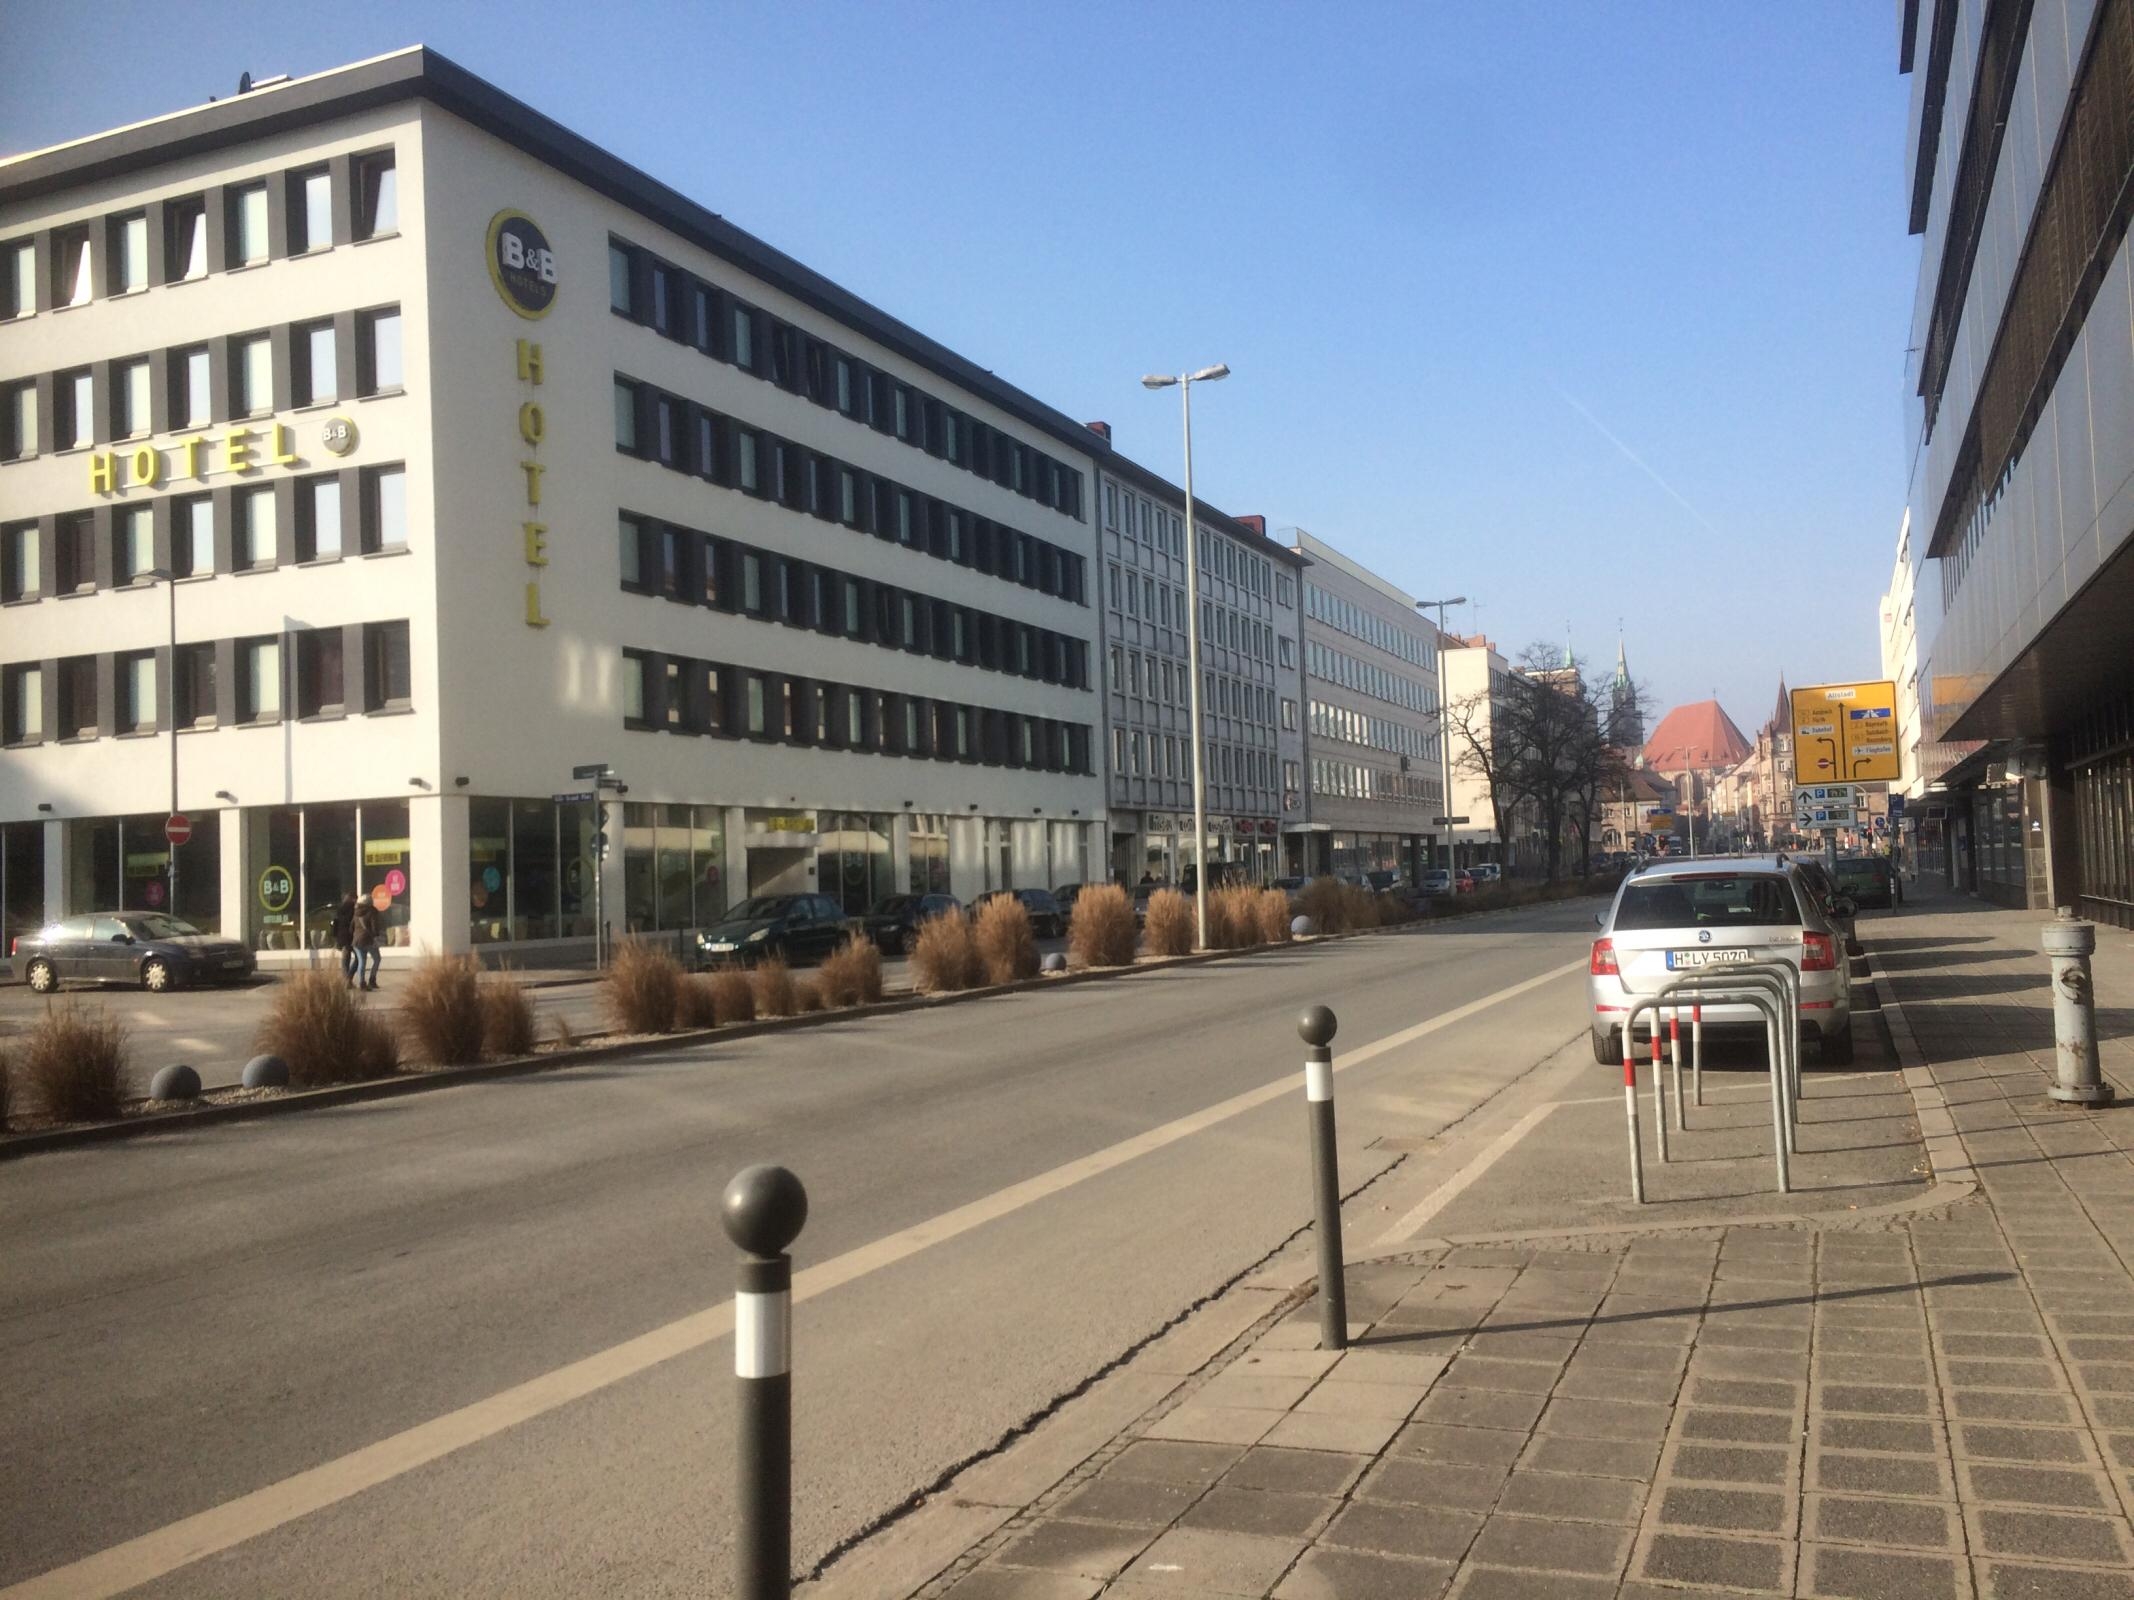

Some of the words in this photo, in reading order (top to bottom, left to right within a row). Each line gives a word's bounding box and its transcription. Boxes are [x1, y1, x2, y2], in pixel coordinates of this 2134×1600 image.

[501, 231, 559, 285] B&B
[322, 425, 347, 441] B&B
[89, 423, 298, 494] HOTEL
[516, 338, 551, 628] HOTEL
[1816, 789, 1824, 798] P
[263, 879, 289, 895] B&B
[1675, 953, 1684, 965] H
